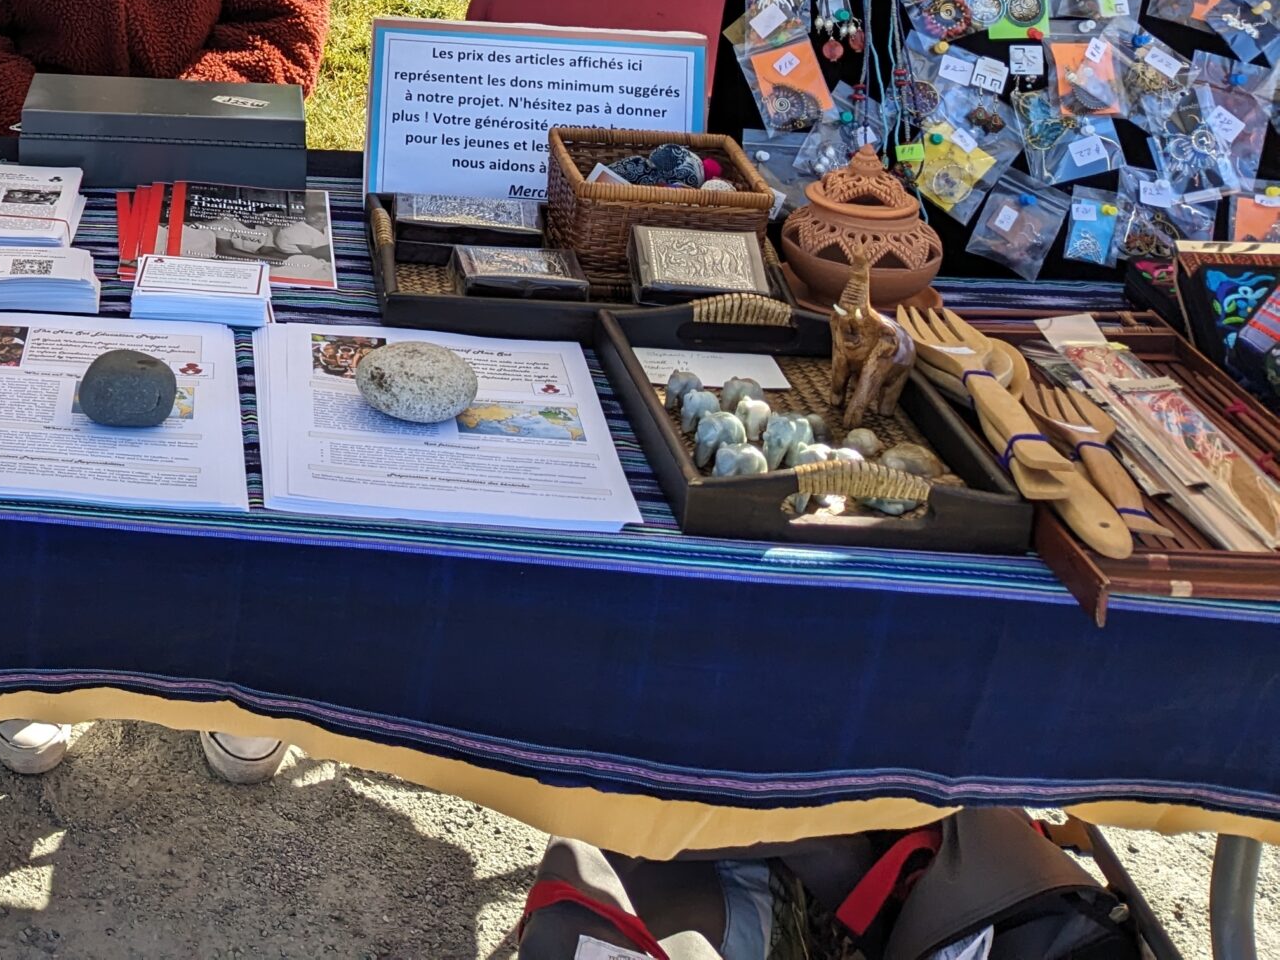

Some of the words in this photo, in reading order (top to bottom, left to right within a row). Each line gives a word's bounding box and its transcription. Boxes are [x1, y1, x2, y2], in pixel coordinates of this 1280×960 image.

[432, 47, 454, 60] Les
[457, 49, 484, 64] prix
[487, 51, 511, 64] des
[515, 52, 565, 67] articles
[569, 54, 624, 71] affichés
[627, 59, 643, 71] ici
[394, 69, 483, 86] représentent
[487, 74, 506, 87] les
[510, 75, 543, 90] dons
[547, 78, 615, 94] minimum
[618, 82, 681, 99] suggérés
[405, 89, 413, 101] à
[416, 92, 454, 104] notre
[458, 93, 504, 109] projet.
[508, 96, 572, 112] N'hésitez
[575, 103, 600, 116] pas
[603, 101, 613, 114] à
[616, 103, 668, 118] donner
[392, 110, 420, 125] plus
[425, 111, 429, 122] !
[433, 113, 471, 126] Votre
[474, 114, 549, 132] générosité
[405, 134, 438, 146] pour
[441, 133, 460, 146] les
[463, 135, 510, 151] jeunes
[513, 139, 528, 151] et
[531, 139, 549, 153] les
[452, 157, 485, 169] nous
[489, 157, 535, 172] aidons
[539, 161, 547, 174] à
[190, 200, 256, 212] Thailand:
[191, 194, 287, 209] Townshippers
